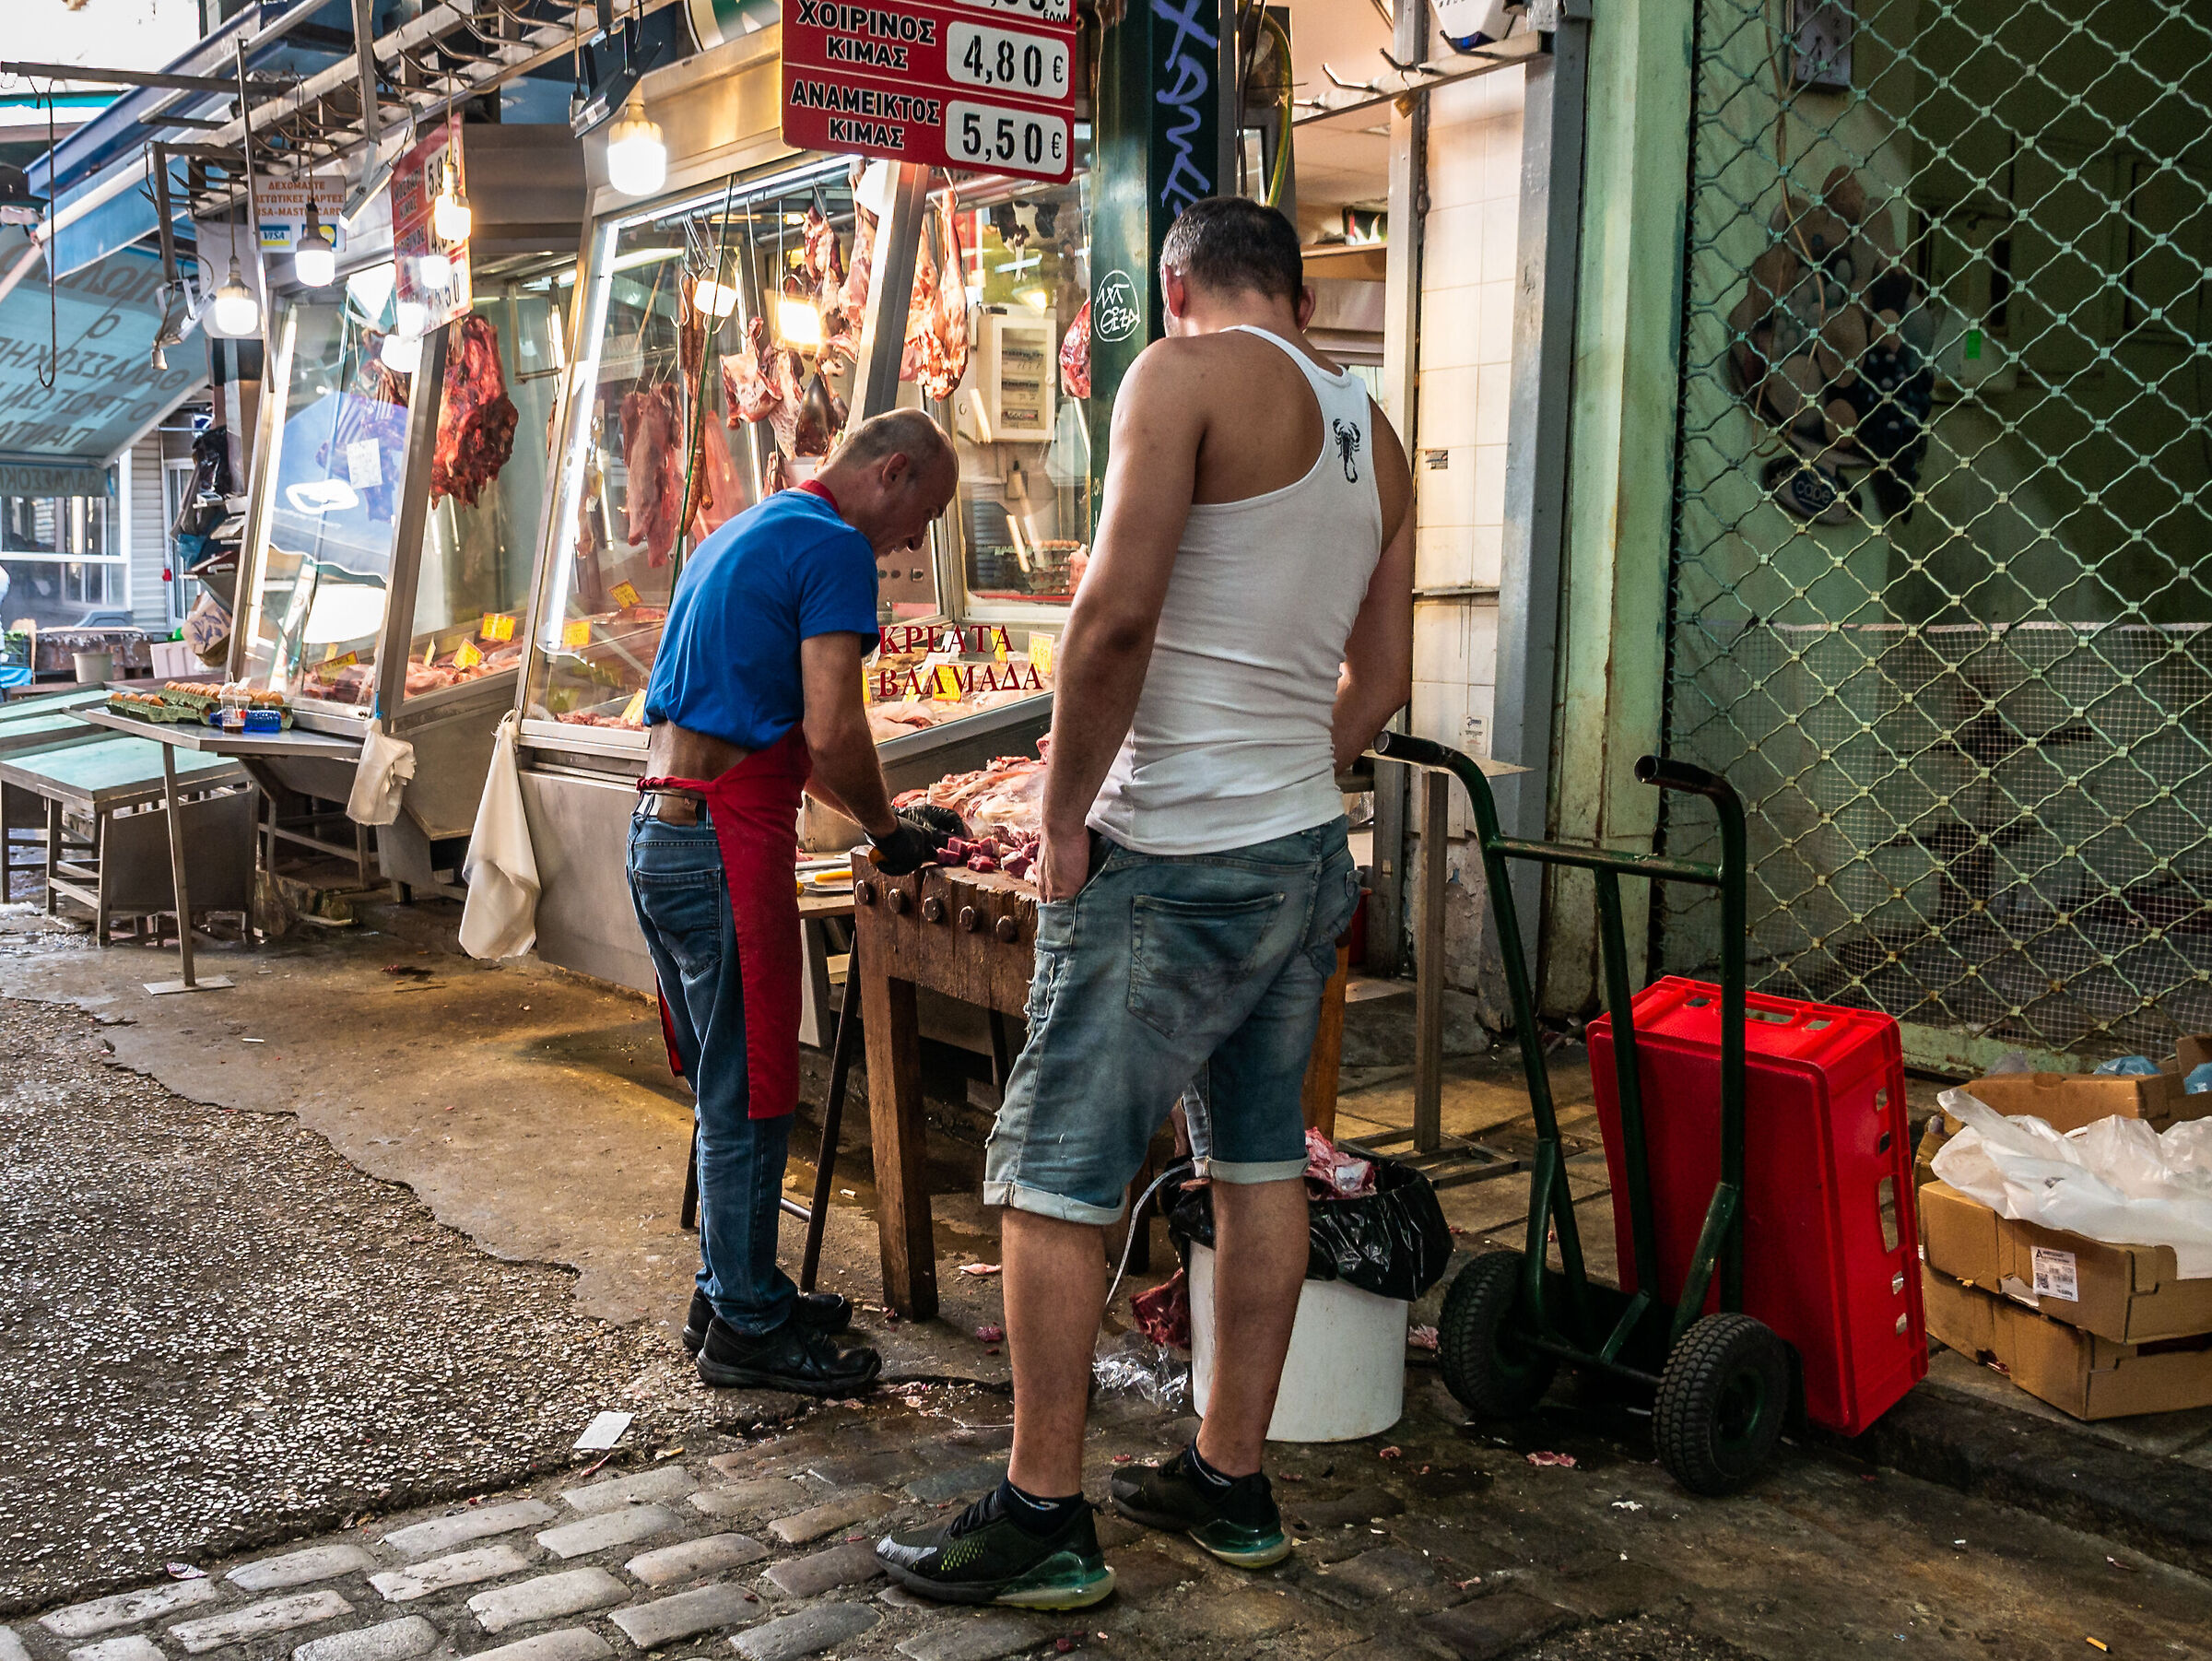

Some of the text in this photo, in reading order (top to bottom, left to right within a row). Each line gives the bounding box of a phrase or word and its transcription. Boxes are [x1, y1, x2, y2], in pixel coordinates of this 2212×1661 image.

[797, 0, 936, 45] ΧΟΙΡΙΝΟΣ
[827, 36, 909, 70] ΚΙΜΑΣ
[963, 35, 1064, 88] 4,80 €
[790, 79, 941, 125] ΑΝΑΜΕΙΚΤΟΣ
[829, 118, 905, 150] ΚΙΜΑΣ
[962, 112, 1062, 164] 5,50 €
[255, 194, 304, 203] ΙΣΤΩΤΙΚΕΣ
[257, 207, 342, 216] ISA-MASTCARD
[264, 231, 285, 240] VISA
[878, 625, 1015, 654] ΚΡΕΑΤΑ
